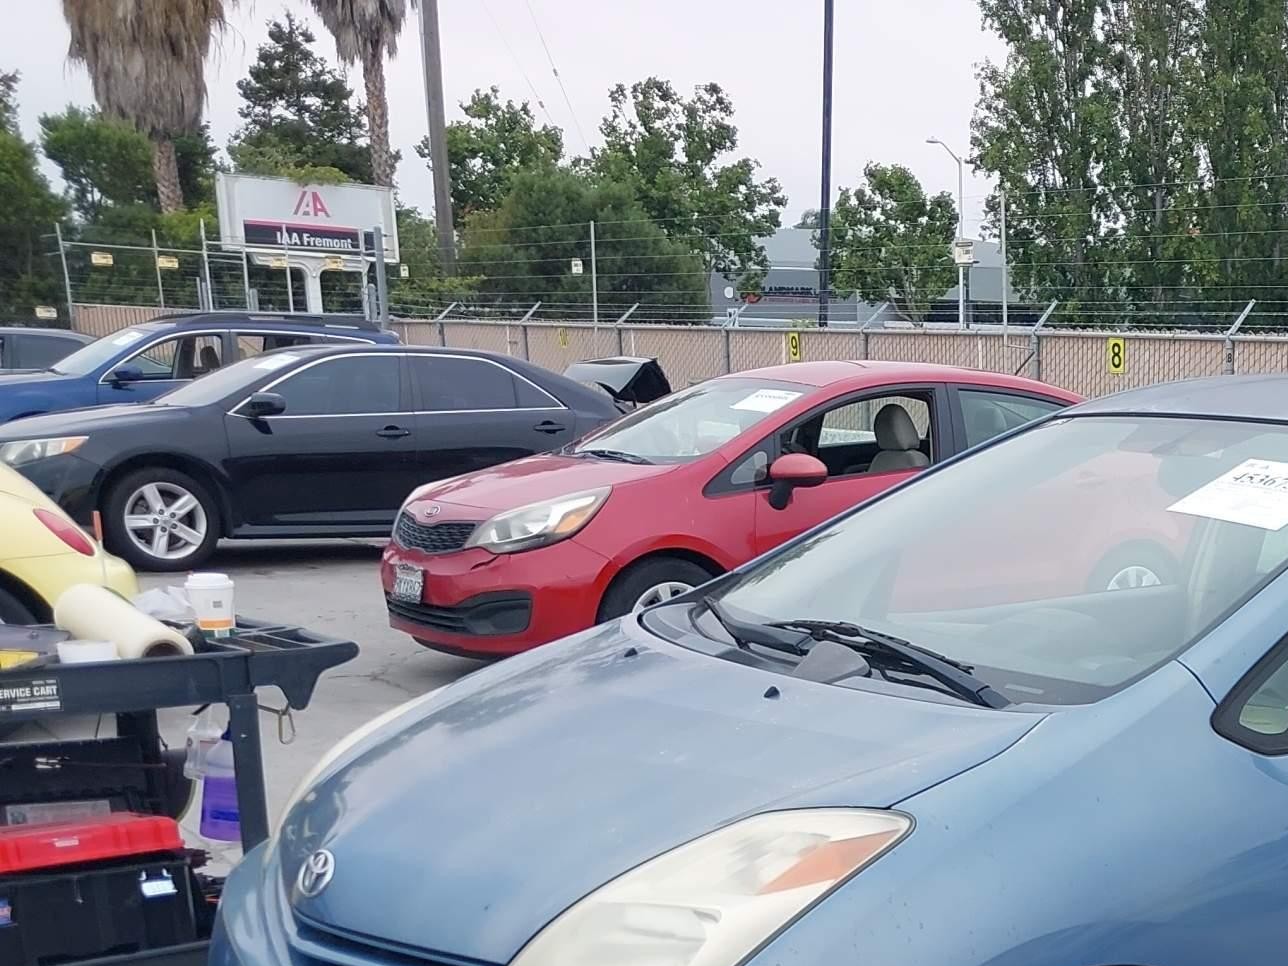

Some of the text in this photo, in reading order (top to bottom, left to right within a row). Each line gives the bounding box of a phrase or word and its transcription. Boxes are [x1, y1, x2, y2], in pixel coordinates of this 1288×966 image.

[277, 231, 352, 249] IAA Fremont
[791, 336, 798, 356] 9
[1111, 343, 1122, 368] 8
[33, 685, 58, 696] CART
